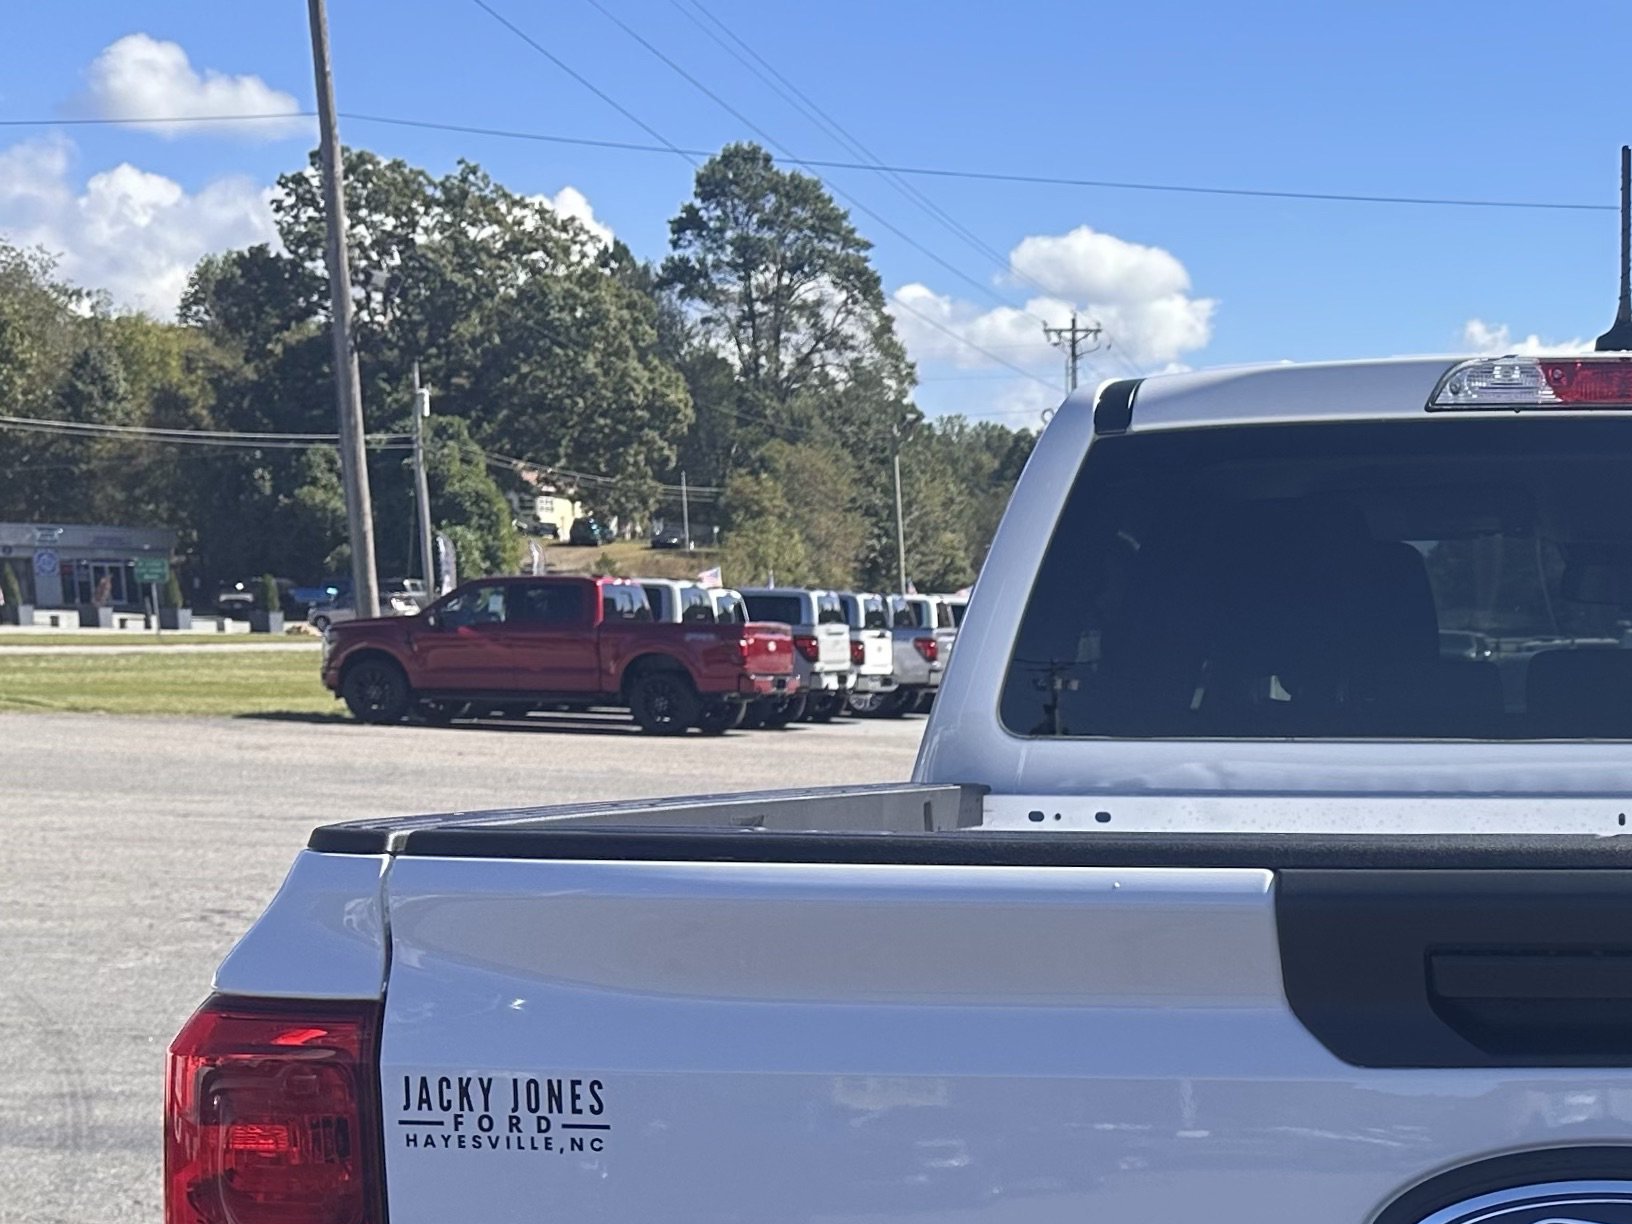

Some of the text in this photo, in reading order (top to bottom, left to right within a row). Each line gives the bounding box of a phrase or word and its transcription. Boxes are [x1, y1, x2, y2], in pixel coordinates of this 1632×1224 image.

[403, 1075, 605, 1116] JACKY JONES
[453, 1113, 552, 1134] FORD
